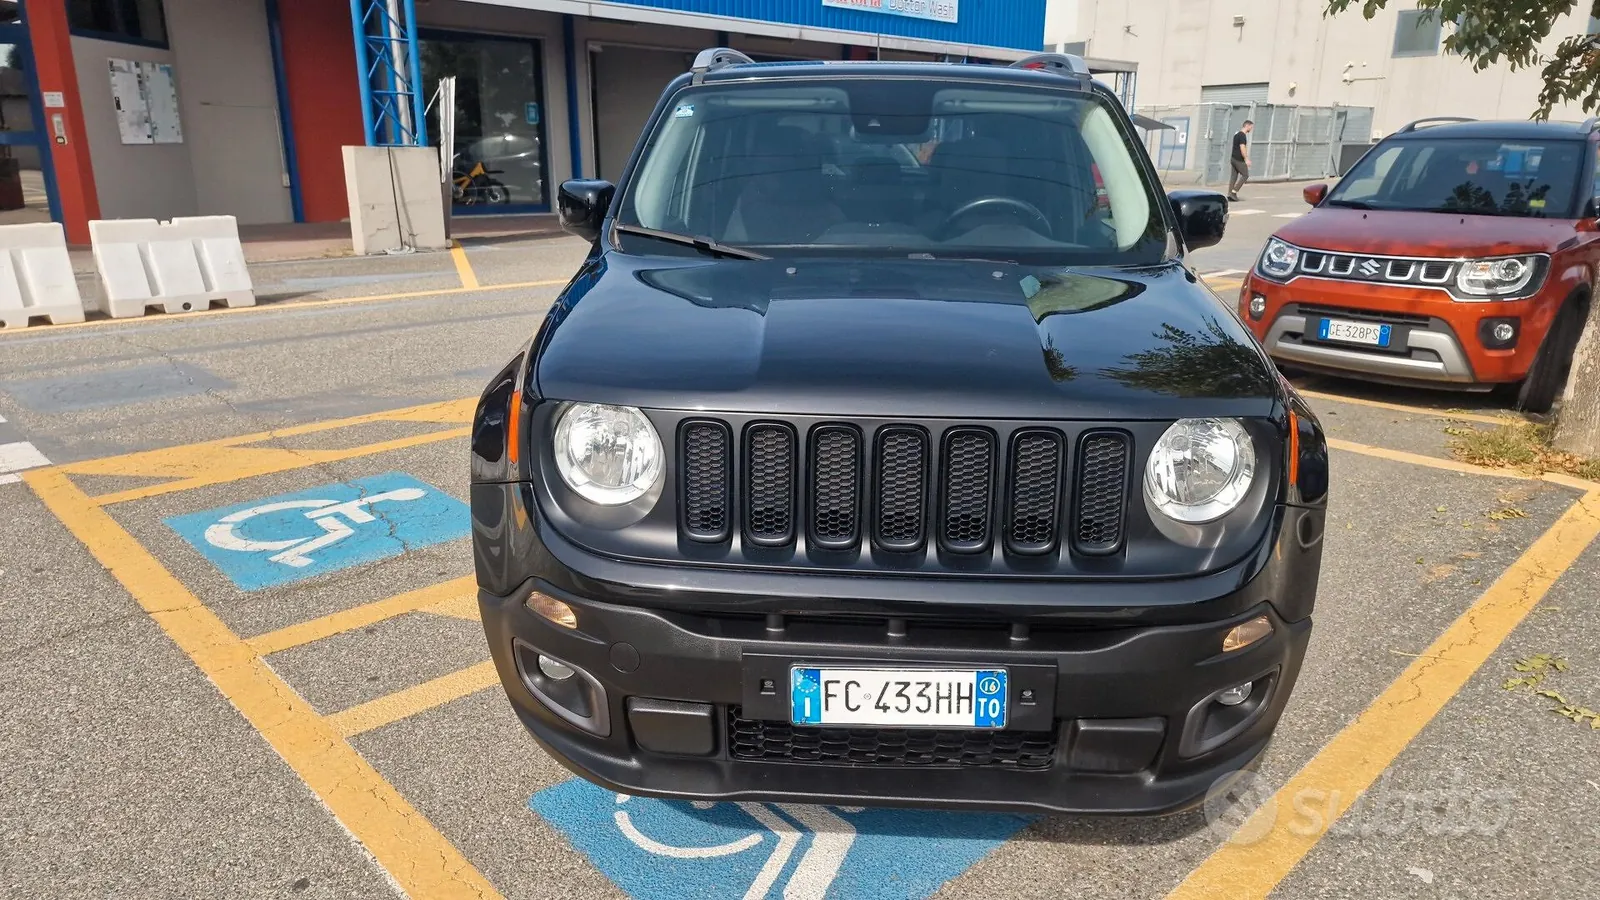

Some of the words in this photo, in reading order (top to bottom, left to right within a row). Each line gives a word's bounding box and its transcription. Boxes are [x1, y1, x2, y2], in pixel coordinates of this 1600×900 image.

[929, 0, 955, 17] Wash
[1345, 325, 1379, 341] 328PS
[824, 680, 861, 712] FC
[874, 681, 974, 714] 433HH
[978, 697, 1000, 718] TO
